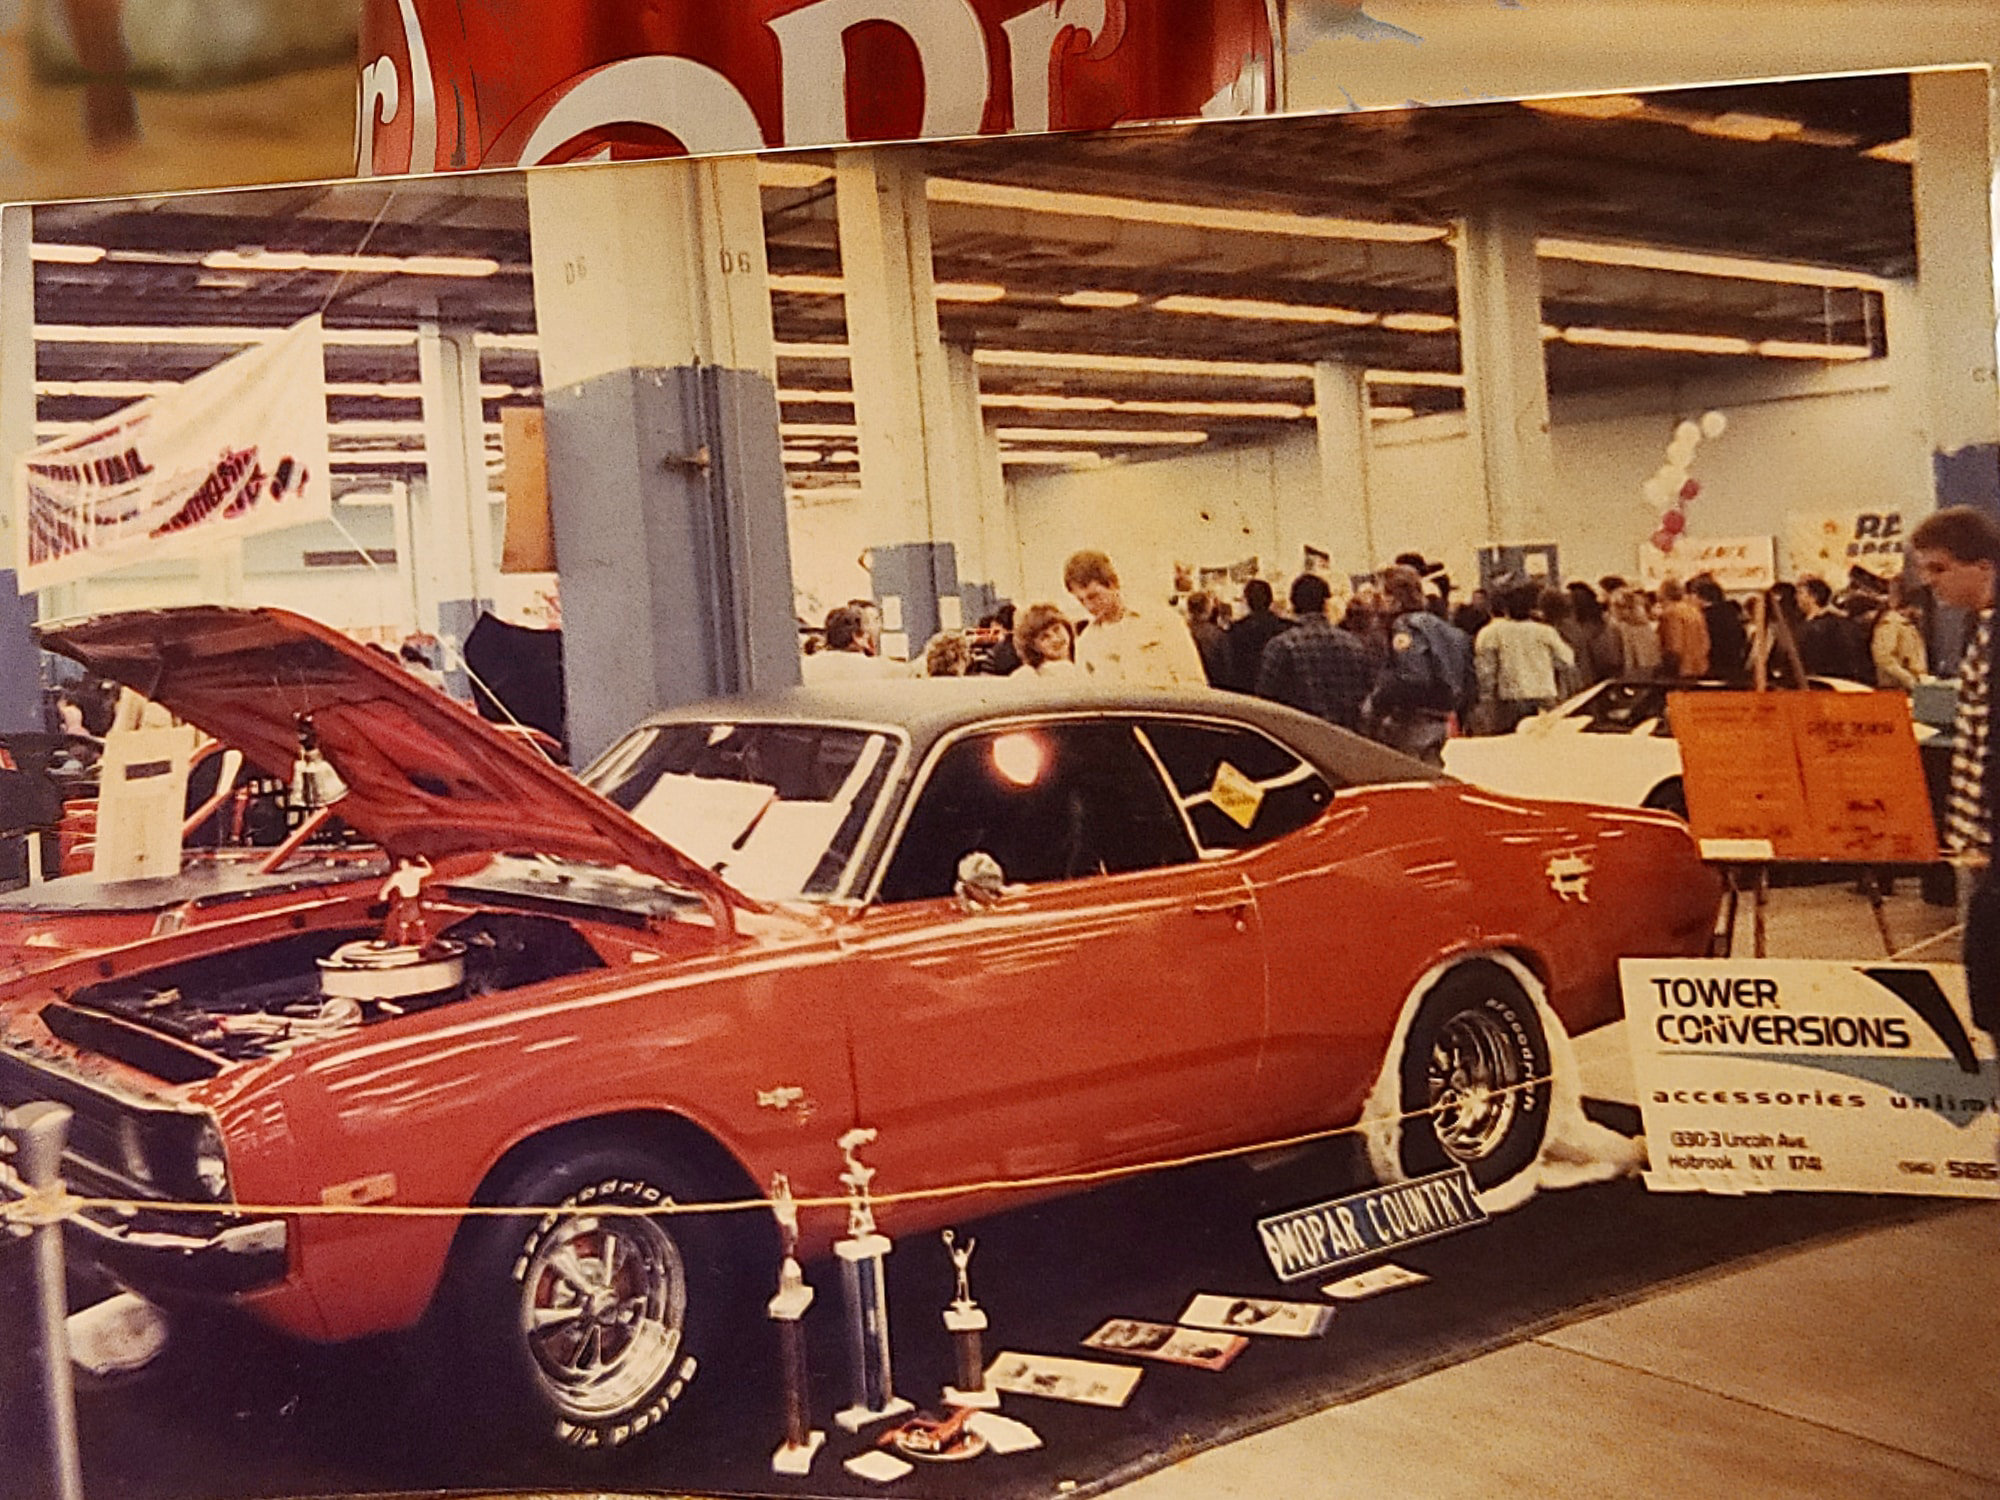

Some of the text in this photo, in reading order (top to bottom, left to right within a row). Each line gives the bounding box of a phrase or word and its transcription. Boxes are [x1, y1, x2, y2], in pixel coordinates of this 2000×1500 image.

[1651, 978, 1779, 1009] TOWER
[1656, 1014, 1911, 1049] CONVERSIONS
[1653, 1090, 1866, 1107] accessories
[1272, 1174, 1476, 1270] MOPAR COUNTRY
